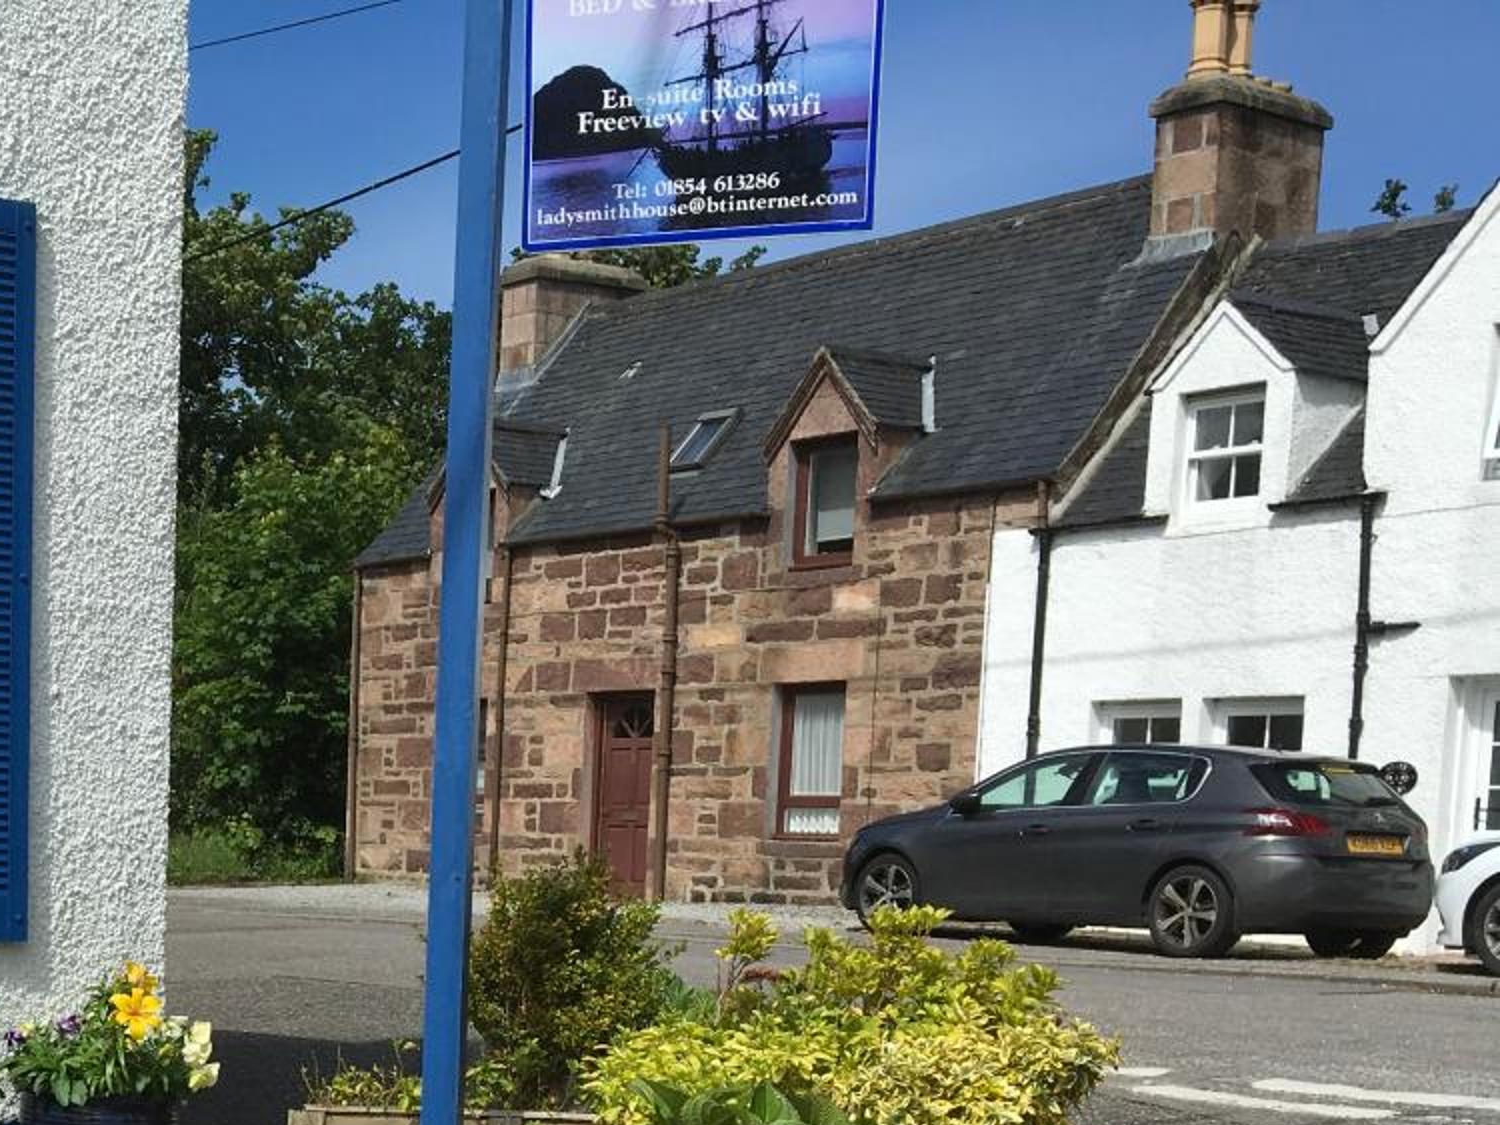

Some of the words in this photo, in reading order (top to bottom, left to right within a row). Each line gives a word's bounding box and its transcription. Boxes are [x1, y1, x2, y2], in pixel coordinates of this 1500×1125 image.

[567, 0, 623, 17] BED
[714, 78, 799, 100] Rooms
[577, 107, 689, 134] Freeview
[700, 107, 727, 125] tv
[735, 101, 760, 121] &
[767, 92, 822, 118] wifi
[611, 181, 648, 201] Tel:
[654, 177, 707, 198] 01854
[713, 171, 780, 193] 613286
[536, 189, 858, 228] ladysmithhouse@btinternet.com
